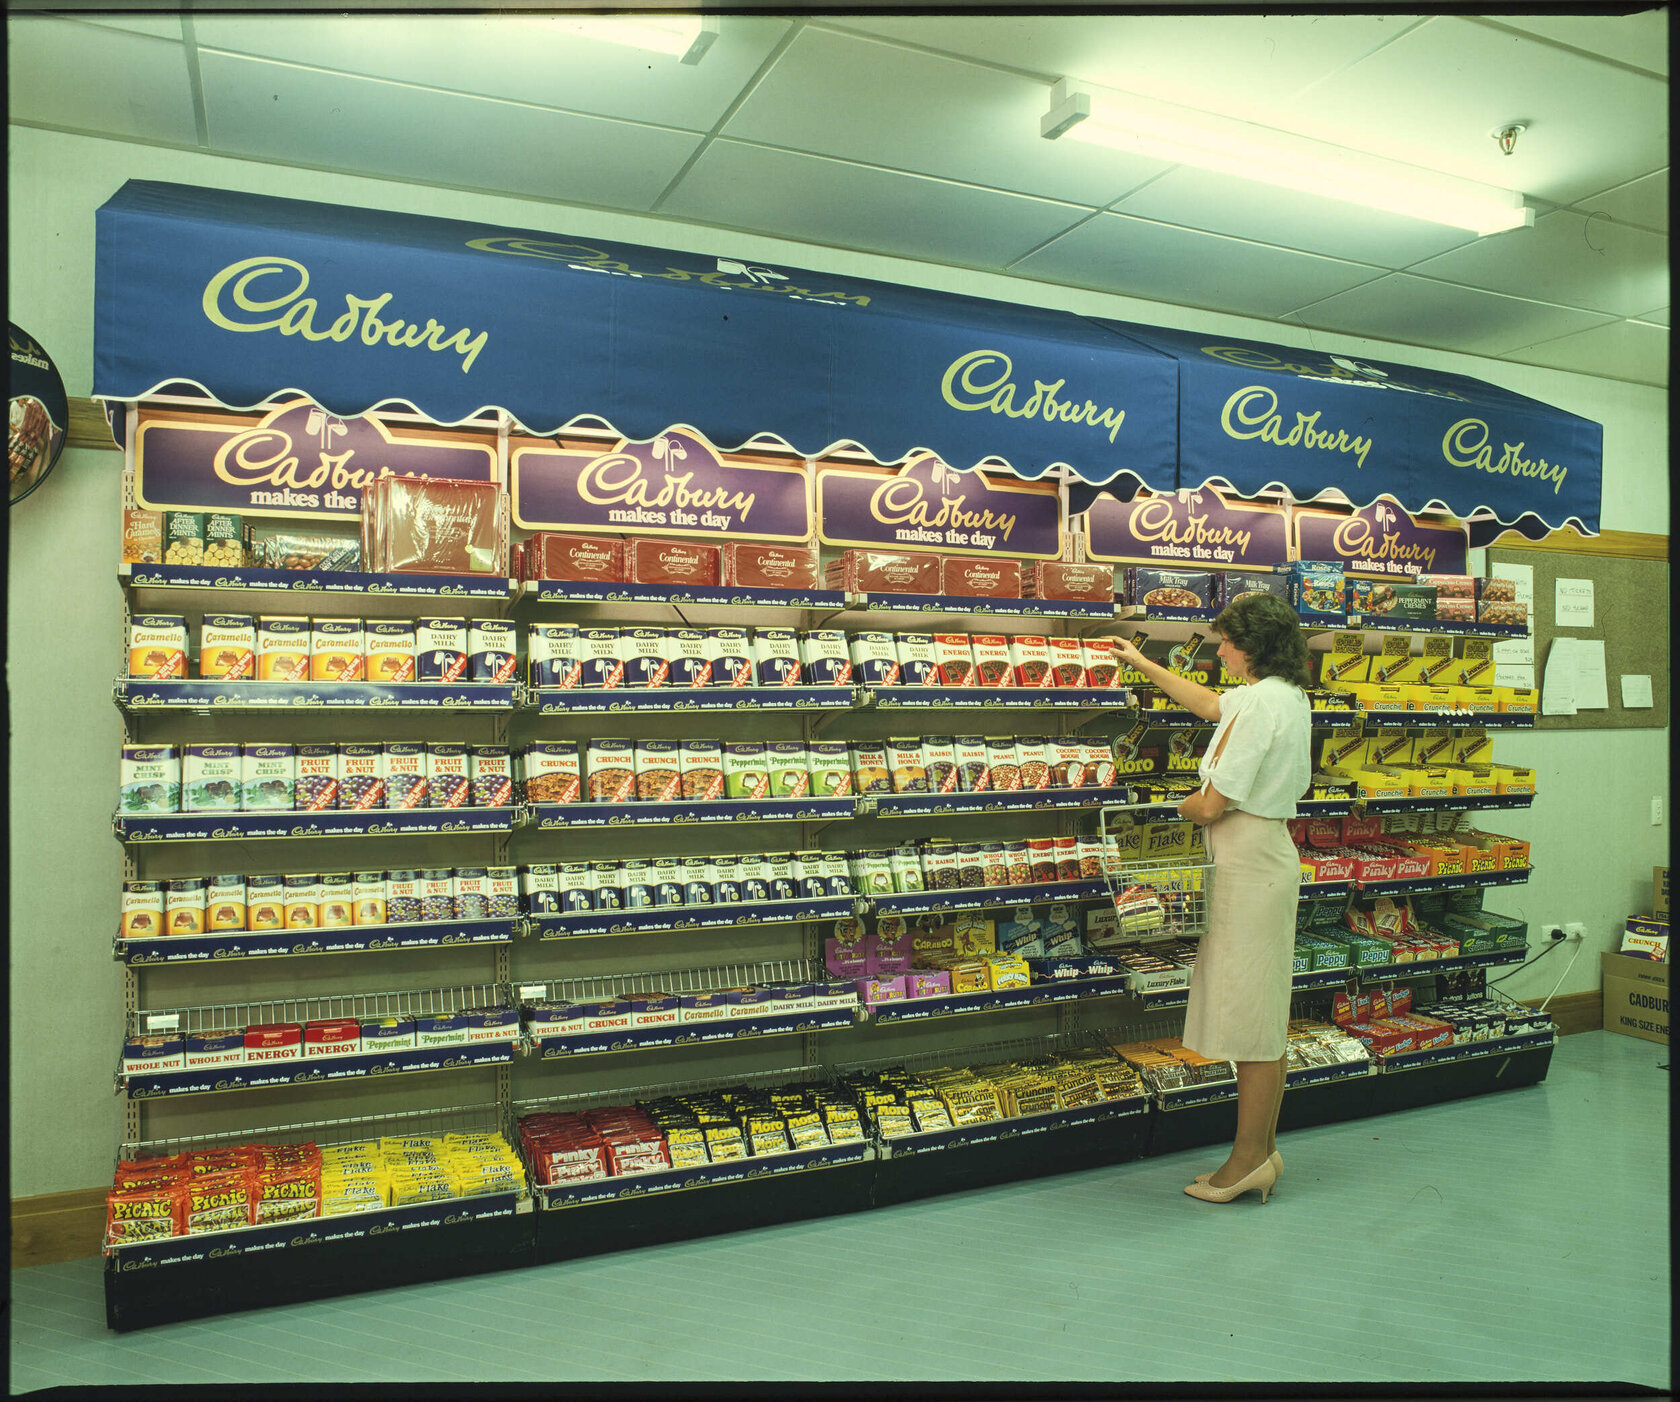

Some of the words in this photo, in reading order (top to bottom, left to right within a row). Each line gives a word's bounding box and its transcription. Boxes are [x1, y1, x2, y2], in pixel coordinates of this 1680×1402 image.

[202, 256, 489, 374] Cadbury
[941, 350, 1126, 443] Cadbury
[1221, 385, 1373, 468] Cadbury
[1442, 418, 1567, 493] Cadbury
[577, 454, 754, 523] Cadbury
[251, 490, 319, 508] makes
[324, 491, 357, 510] the
[870, 477, 1015, 542] Cadbury
[609, 506, 666, 524] makes
[670, 509, 697, 525] the
[701, 510, 731, 530] day
[169, 523, 199, 531] DINNER
[207, 525, 236, 534] DINNER
[1129, 498, 1251, 555] Cadbury
[896, 527, 943, 543] makes
[946, 529, 968, 545] the
[970, 530, 996, 549] day
[1333, 517, 1436, 570] Cadbury
[570, 548, 610, 560] Continental
[660, 552, 698, 564] Continental
[1152, 543, 1191, 557] makes
[1193, 546, 1212, 559] the
[1214, 547, 1234, 562] day
[758, 557, 795, 568] Continental
[1352, 559, 1385, 572] makes
[1386, 561, 1403, 573] the
[1404, 562, 1422, 575] day
[880, 564, 918, 574] Continental
[965, 569, 1000, 579] Continental
[1062, 573, 1095, 583] Continental
[1159, 575, 1174, 585] Milk
[1174, 577, 1188, 588] Tray
[1398, 597, 1432, 605] PEPPERMINT
[134, 632, 183, 643] Caramello
[205, 632, 252, 643] Caramello
[430, 632, 458, 640] DAIRY
[263, 637, 308, 649] Caramello
[316, 637, 359, 648] Caramello
[370, 638, 413, 649] Caramello
[433, 639, 456, 647] MILK
[1375, 702, 1402, 710] Crunchie
[1507, 704, 1532, 712] Crunchie
[301, 759, 330, 767] FRUIT
[478, 759, 506, 767] FRUIT
[540, 759, 577, 768] CRUNCH
[595, 755, 631, 763] CRUNCH
[686, 755, 720, 763] CRUNCH
[134, 771, 165, 779] CRISP
[202, 768, 233, 776] CRISP
[301, 766, 308, 774] &
[310, 766, 330, 774] NUT
[479, 766, 486, 774] &
[487, 766, 506, 774] NUT
[1150, 832, 1185, 850] Flake
[1319, 862, 1352, 877] Pinky
[1362, 864, 1396, 878] Pinky
[1397, 860, 1430, 875] Pinky
[1628, 937, 1661, 947] CRUNCH
[1316, 954, 1346, 966] Peppy
[1361, 950, 1389, 962] Peppy
[1054, 968, 1079, 978] Whip
[1088, 965, 1114, 975] Whip
[773, 1003, 795, 1012] DAIRY
[797, 1001, 813, 1009] MILK
[817, 999, 839, 1007] DAIRY
[840, 996, 857, 1005] MILK
[684, 1008, 724, 1021] Caramello
[730, 1004, 769, 1017] Caramello
[588, 1018, 628, 1029] CRUNCH
[636, 1014, 675, 1024] CRUNCH
[1620, 1016, 1637, 1028] KING
[1639, 1020, 1654, 1031] SIZE
[536, 1025, 559, 1034] FRUIT
[569, 1023, 583, 1031] NUT
[366, 1036, 411, 1050] Peppermint
[421, 1032, 466, 1045] Peppermint
[247, 1048, 298, 1061] ENERGY
[308, 1043, 357, 1055] ENERGY
[189, 1055, 218, 1065] WHOLE
[220, 1052, 241, 1063] NUT
[126, 1061, 157, 1072] WHOLE
[159, 1060, 181, 1069] NUT
[827, 1109, 859, 1123] Moro
[750, 1119, 784, 1134] Moro
[705, 1125, 741, 1141] Moro
[403, 1137, 431, 1148] Flake
[615, 1140, 660, 1157] Pinky
[552, 1147, 600, 1164] Pinky
[344, 1183, 376, 1196] Flake
[418, 1180, 450, 1194] Flake
